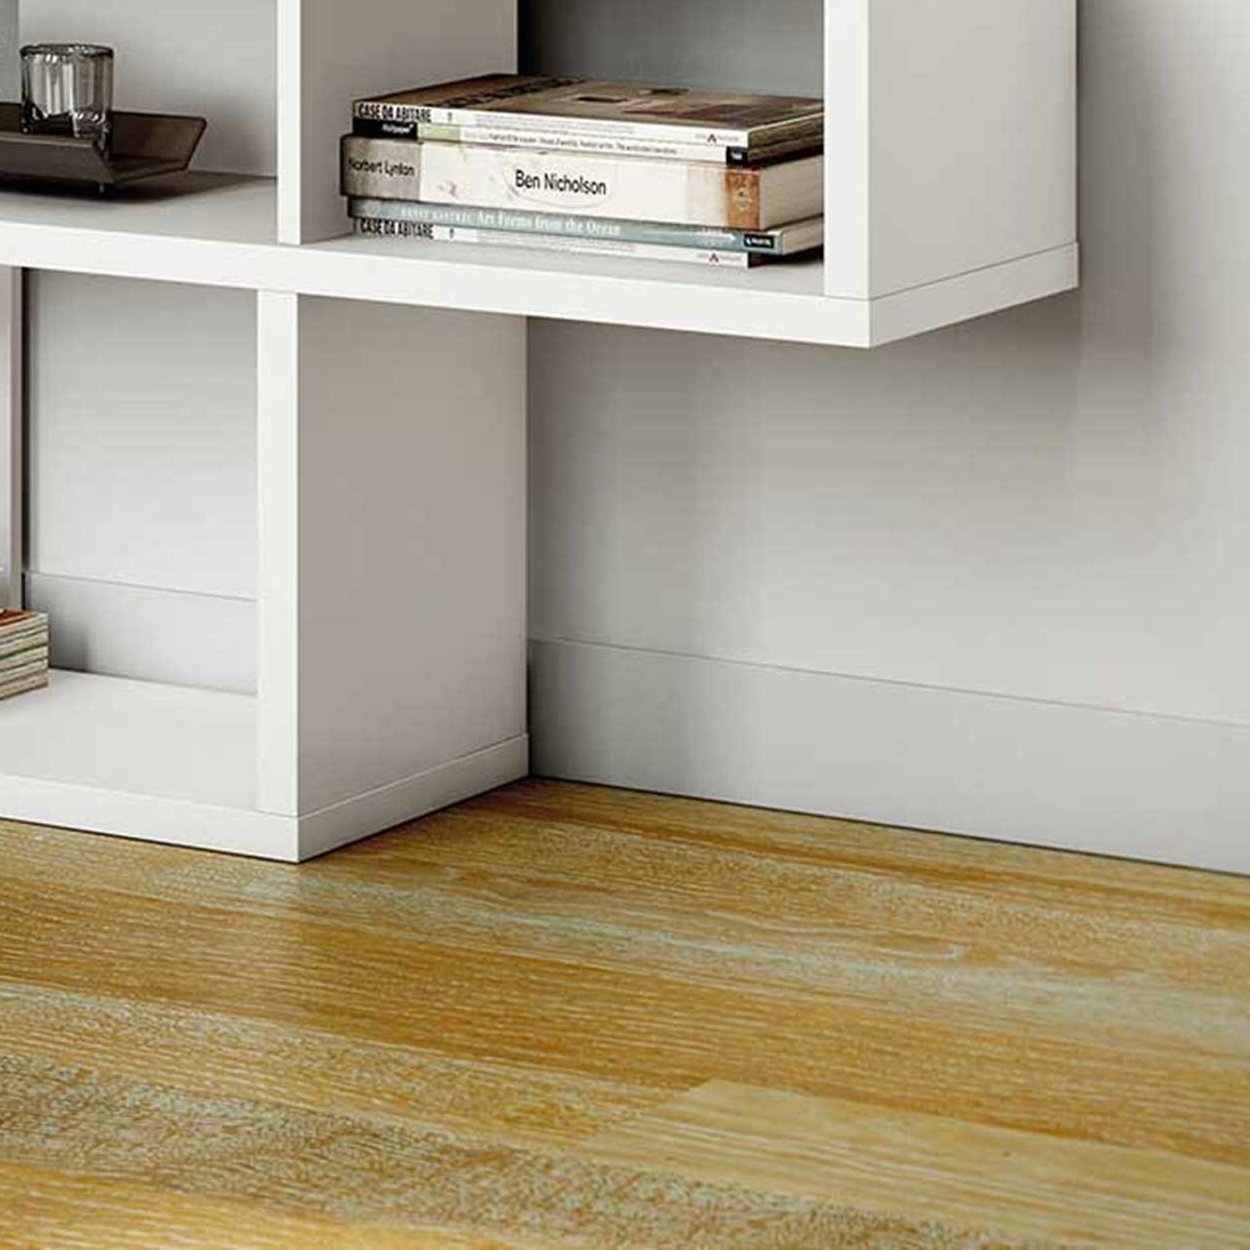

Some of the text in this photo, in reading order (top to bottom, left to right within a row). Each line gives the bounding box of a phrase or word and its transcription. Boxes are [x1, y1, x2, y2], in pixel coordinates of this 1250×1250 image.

[357, 103, 432, 123] CASE DA ABITARE
[349, 158, 382, 175] Norbert
[515, 169, 607, 196] Ben Nicholson
[360, 220, 434, 240] CASE DA ABITARE
[477, 212, 494, 225] Art
[565, 218, 582, 232] the
